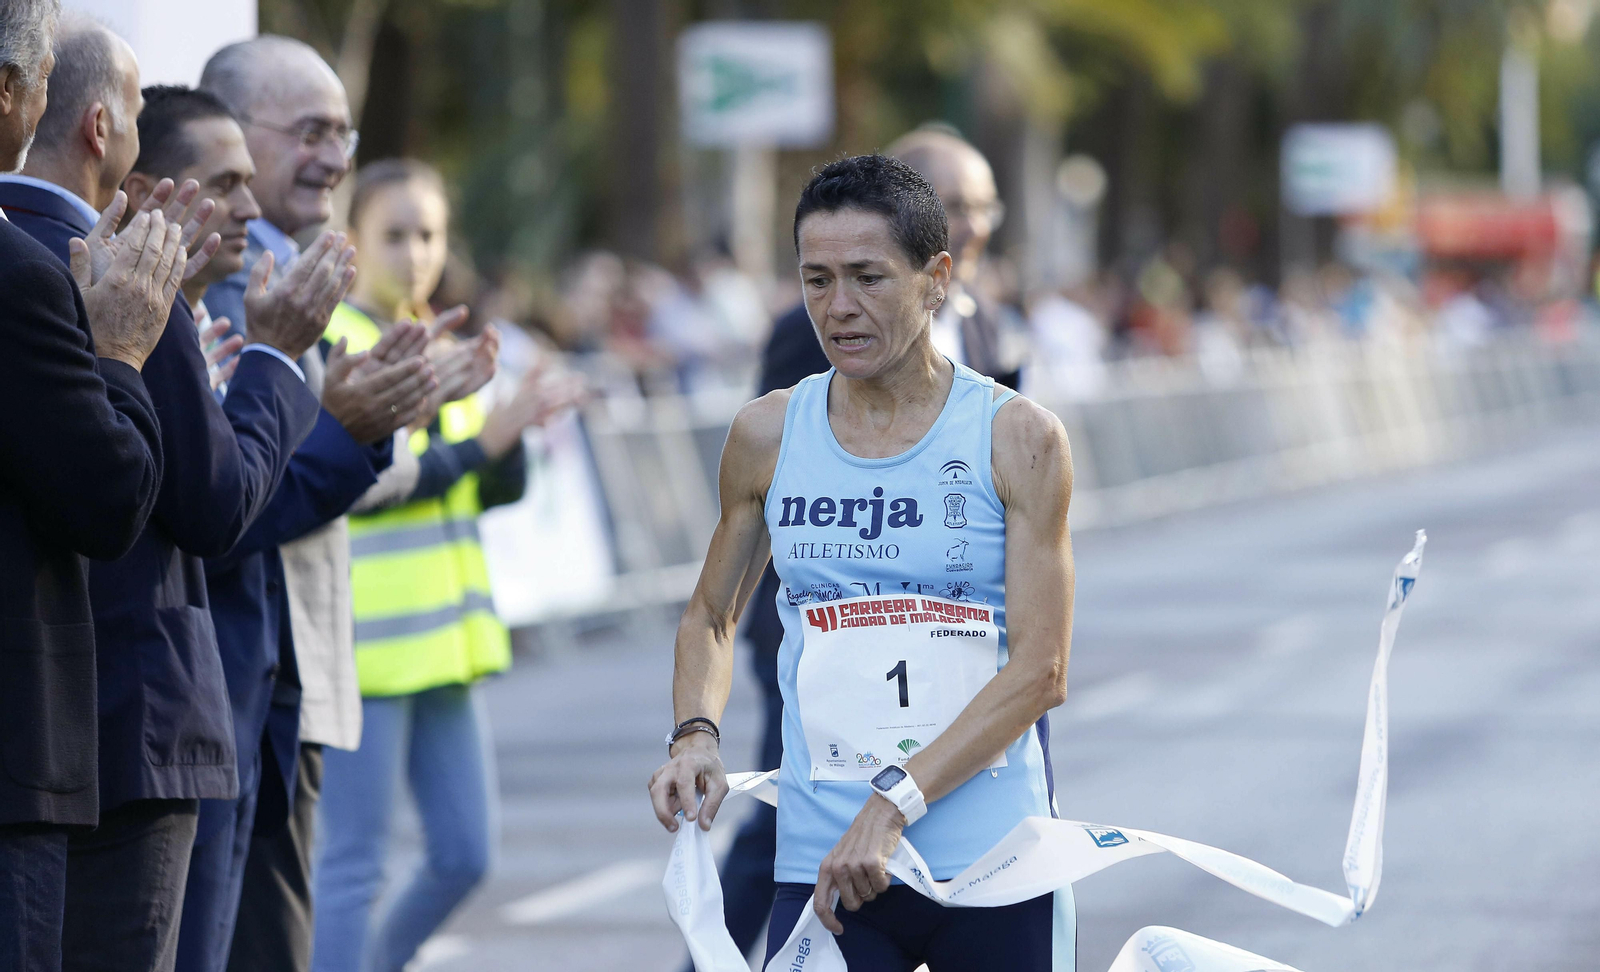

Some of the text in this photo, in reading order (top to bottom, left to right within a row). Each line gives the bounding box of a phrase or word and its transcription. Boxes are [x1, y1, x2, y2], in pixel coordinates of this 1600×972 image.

[778, 486, 924, 540] nerja
[787, 541, 900, 560] ATLETISMO
[806, 598, 991, 633] 41 CARRERA URBANA
[840, 615, 887, 629] CIUDAD
[890, 613, 908, 626] DE
[930, 629, 987, 639] FEDERADO
[886, 660, 909, 708] 1
